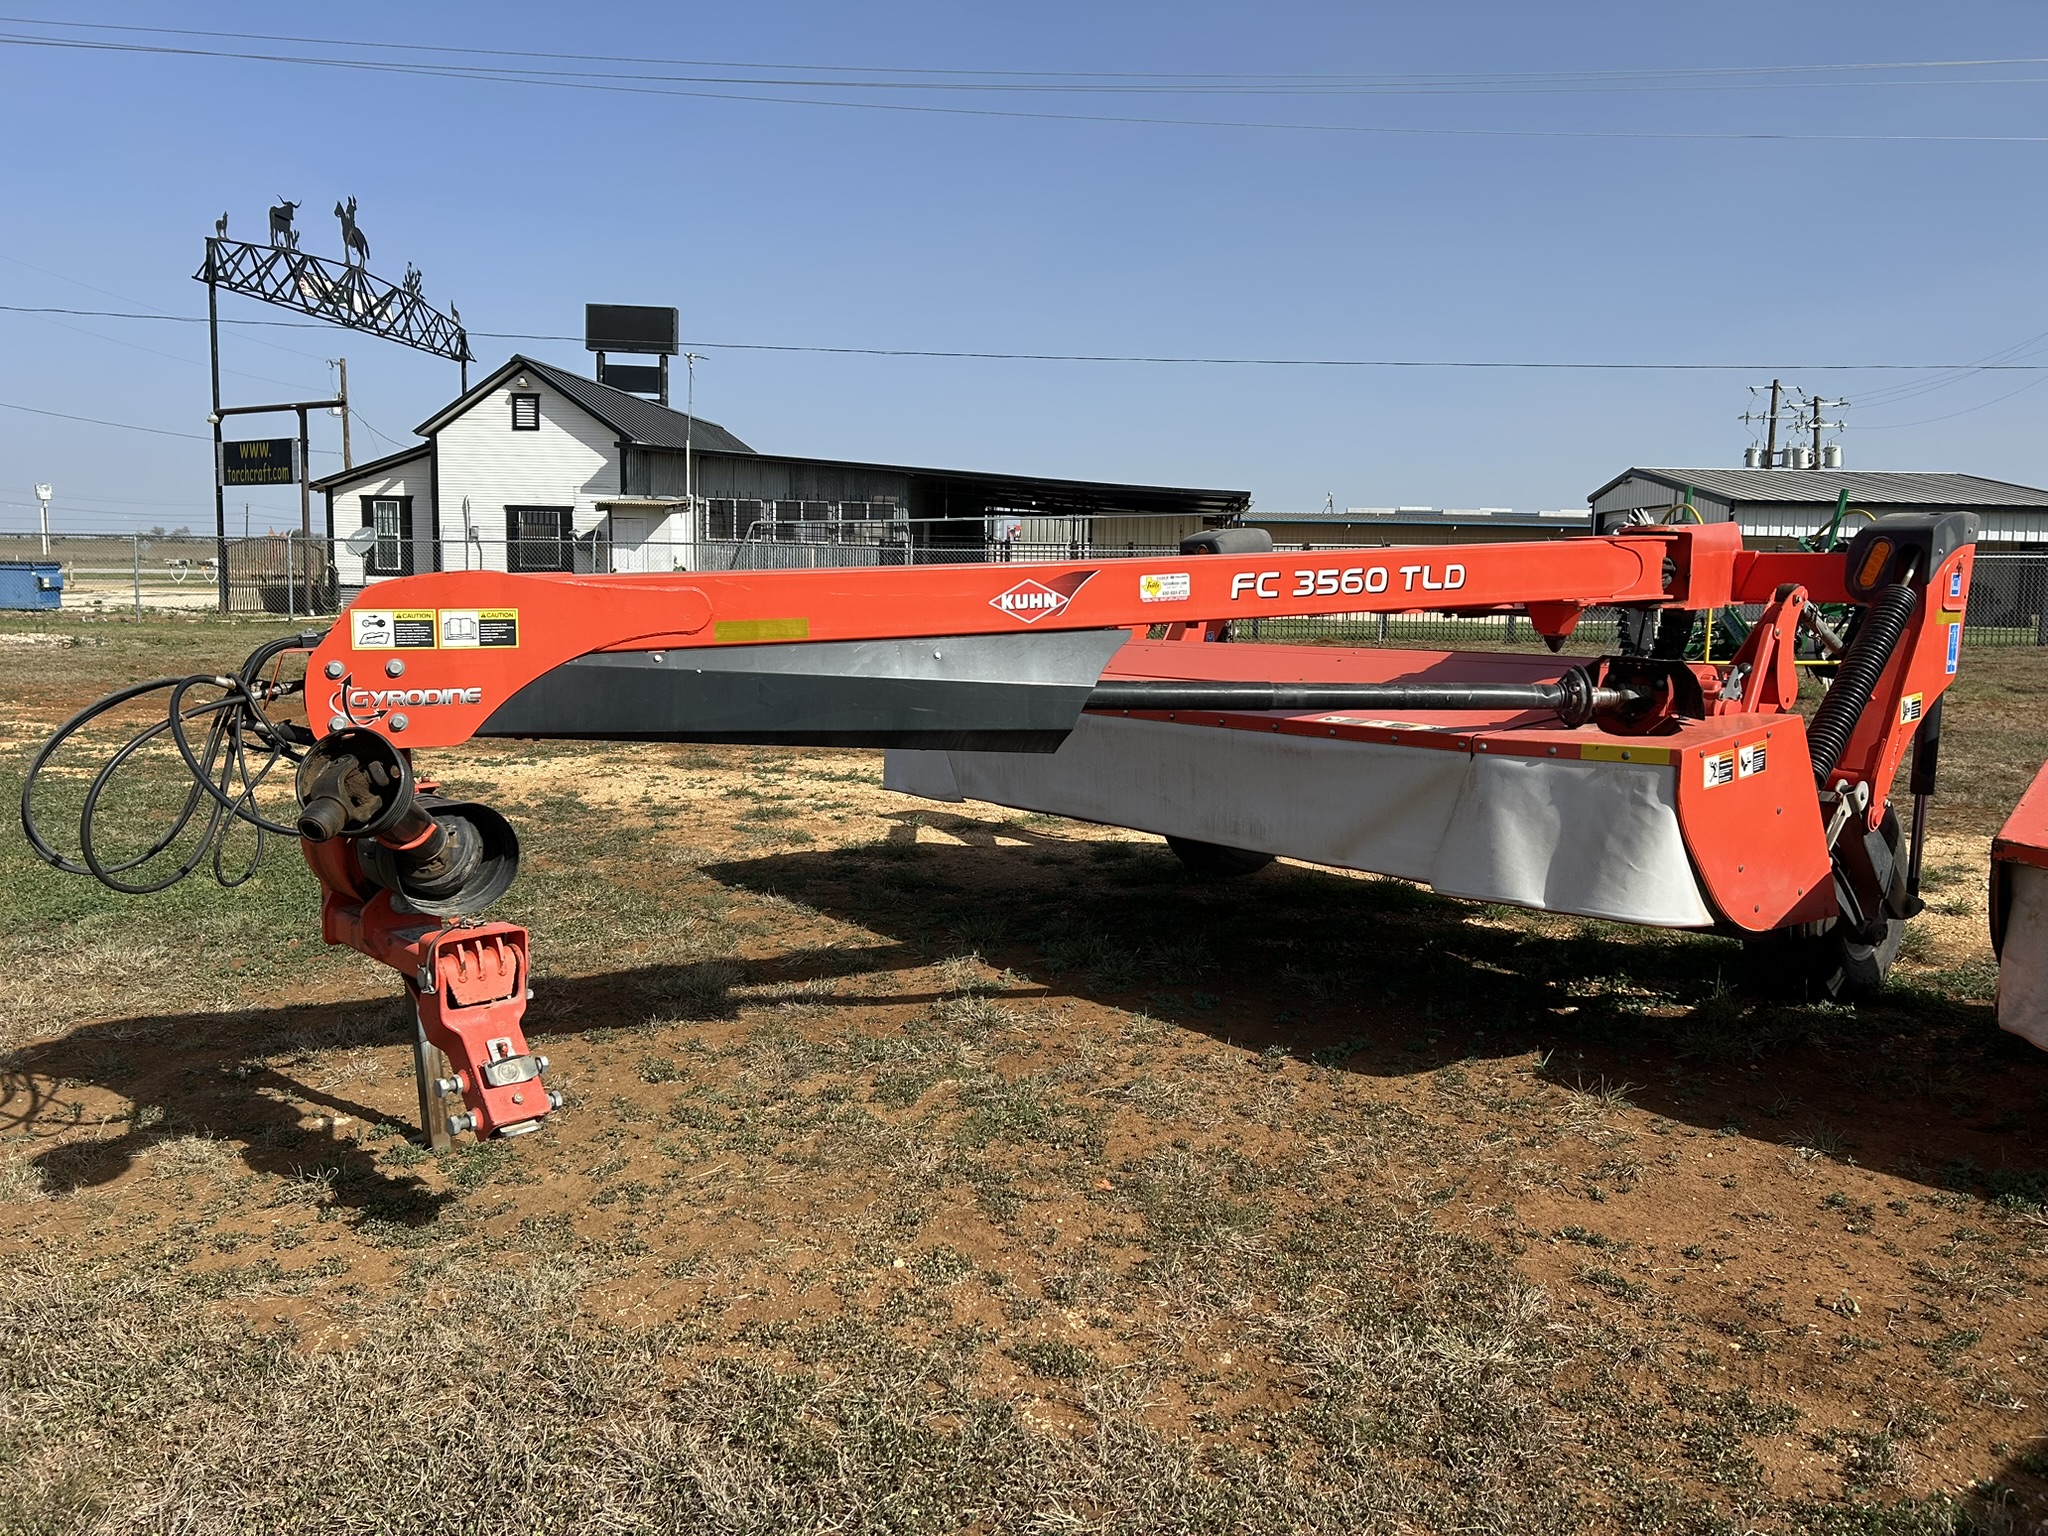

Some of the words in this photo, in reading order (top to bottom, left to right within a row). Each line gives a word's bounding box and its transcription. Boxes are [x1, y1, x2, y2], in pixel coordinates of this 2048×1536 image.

[227, 462, 290, 482] torchcraft.com
[1230, 571, 1281, 600] FC
[1292, 566, 1389, 597] 3560
[1399, 564, 1467, 592] TLD
[1001, 592, 1057, 610] KUHN
[349, 687, 482, 708] GYRODINE
